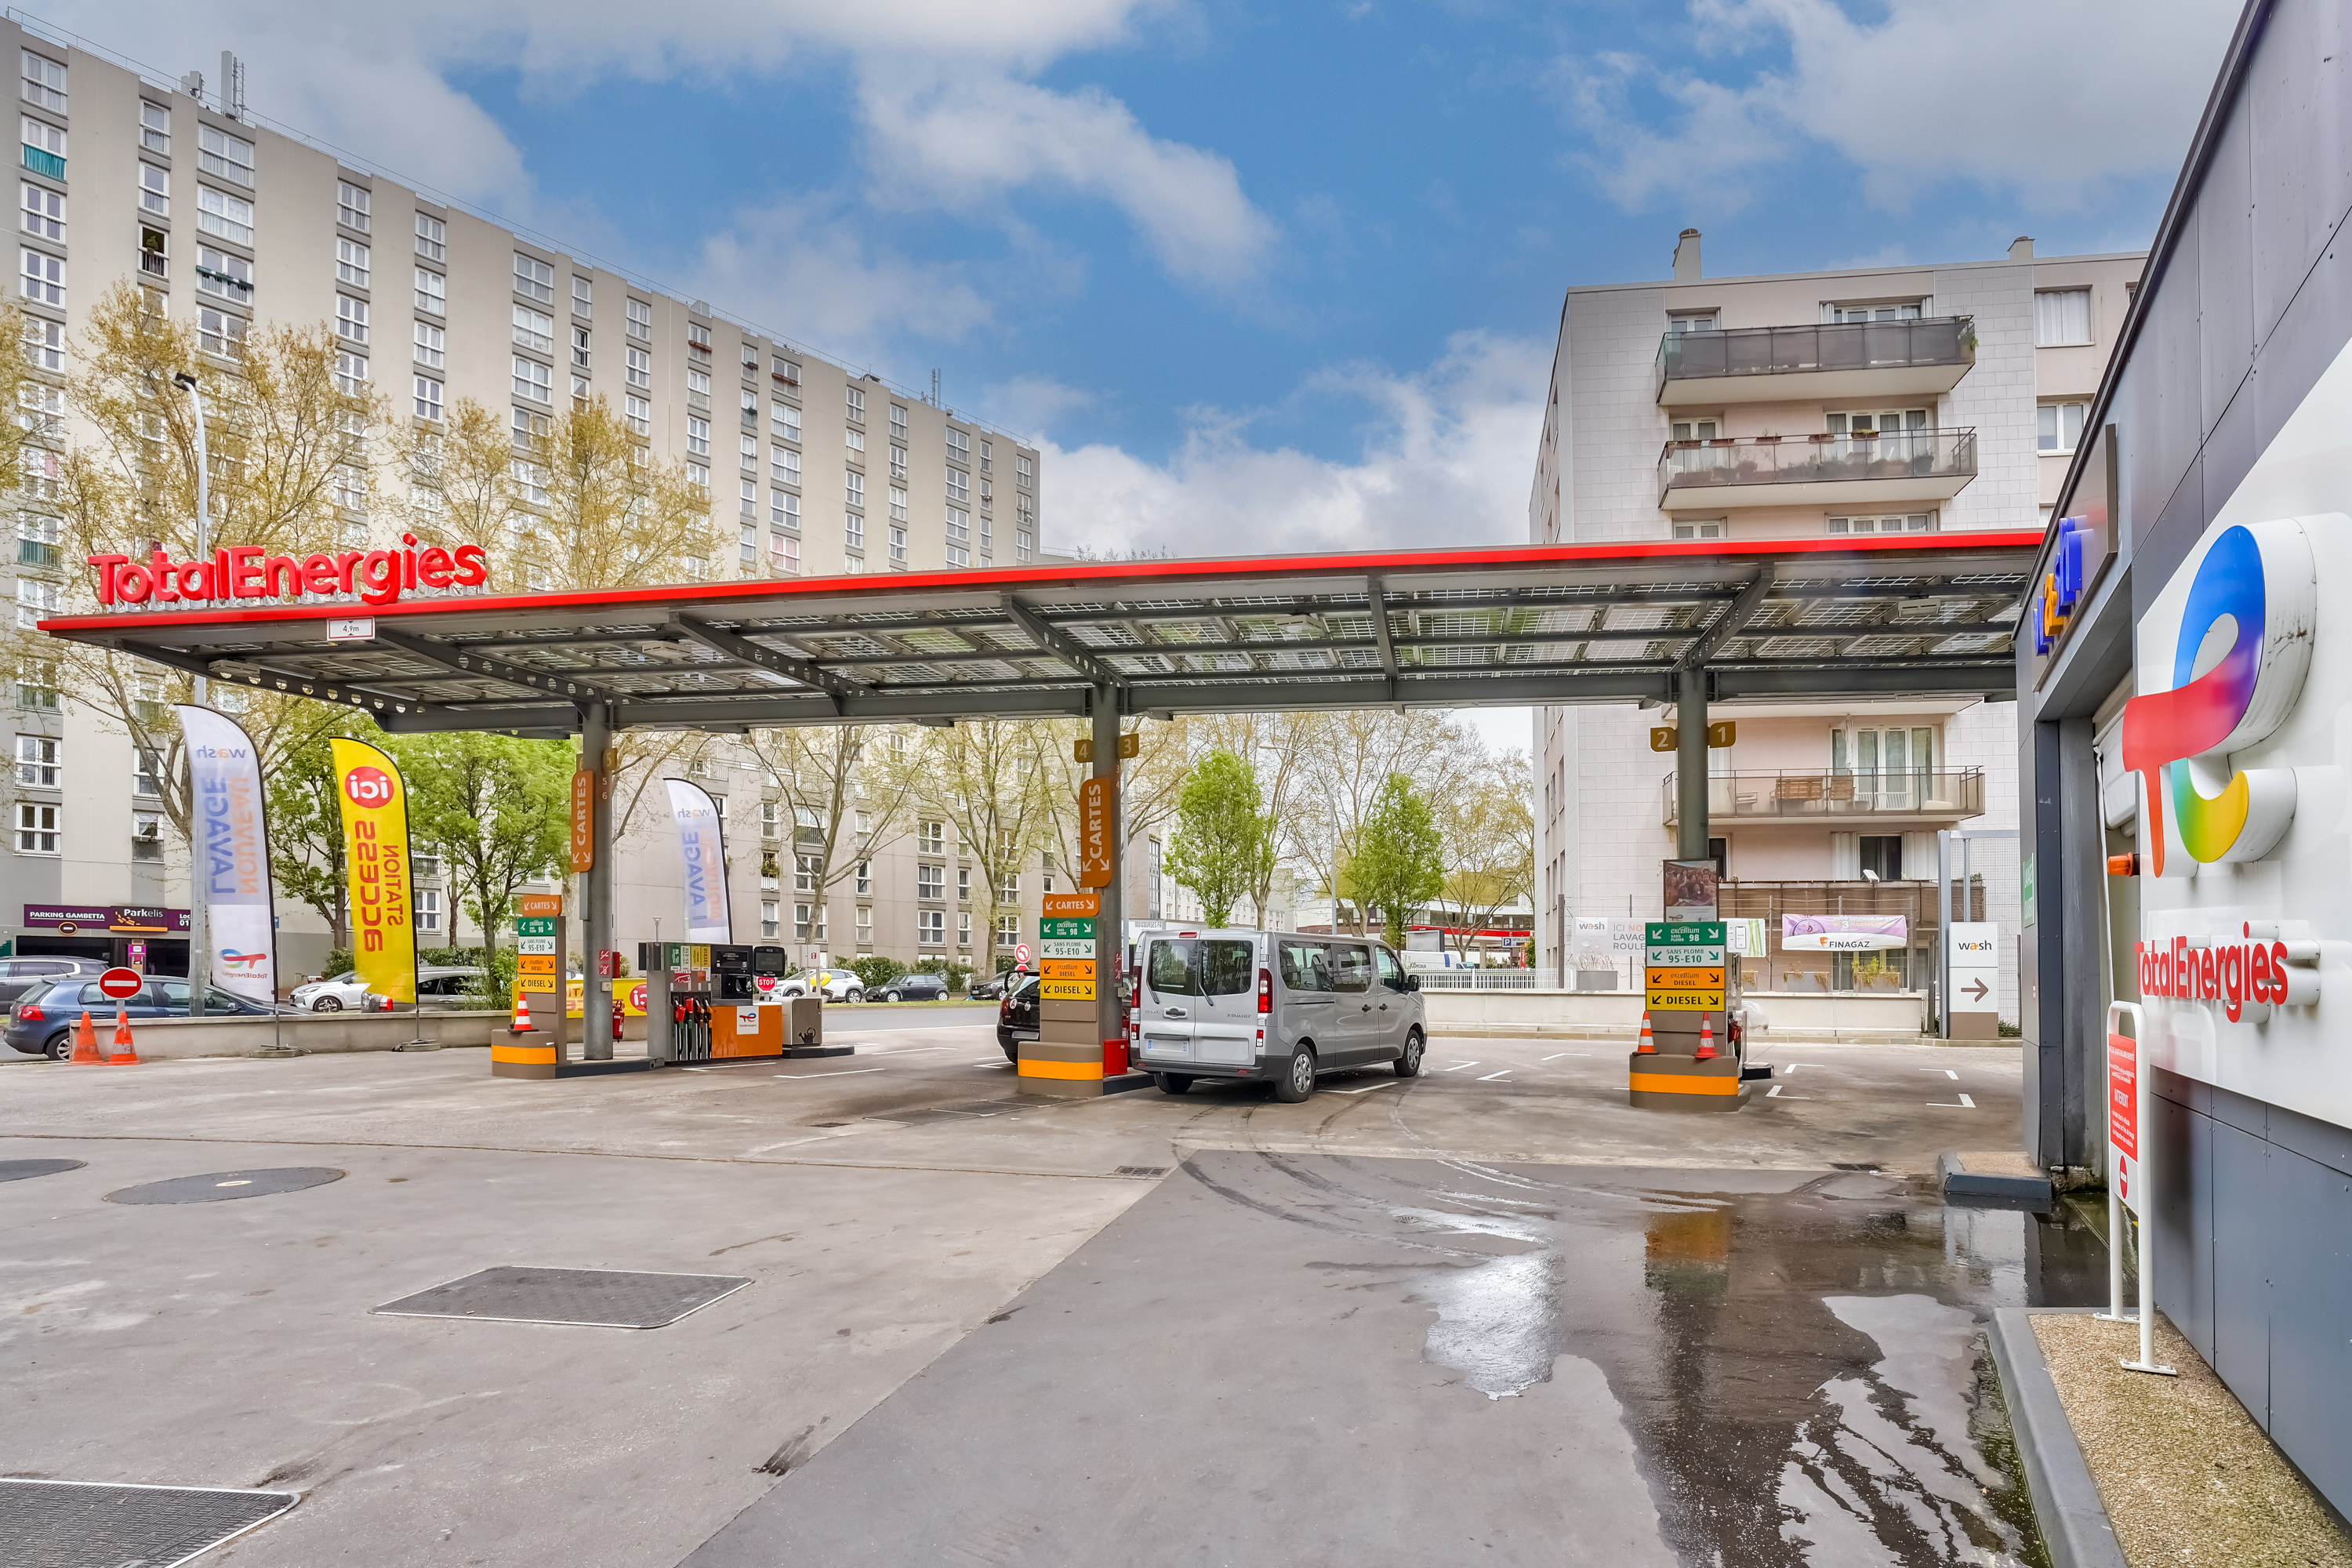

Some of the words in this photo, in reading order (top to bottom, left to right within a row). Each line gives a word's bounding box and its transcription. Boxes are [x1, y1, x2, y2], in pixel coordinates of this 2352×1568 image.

[88, 532, 487, 604] TotalEnergies
[1657, 731, 1668, 747] 2
[1717, 726, 1726, 743] 1
[1079, 743, 1088, 758] 4
[1123, 738, 1131, 754] 3
[607, 753, 612, 767] 5
[577, 777, 586, 846] CARTES
[1088, 784, 1102, 858] CARTES
[124, 909, 163, 917] Parkelis
[1056, 901, 1084, 909] CARTES
[1579, 921, 1605, 930] wash
[1958, 940, 1992, 950] wash
[2134, 921, 2288, 1022] TotalEnergies
